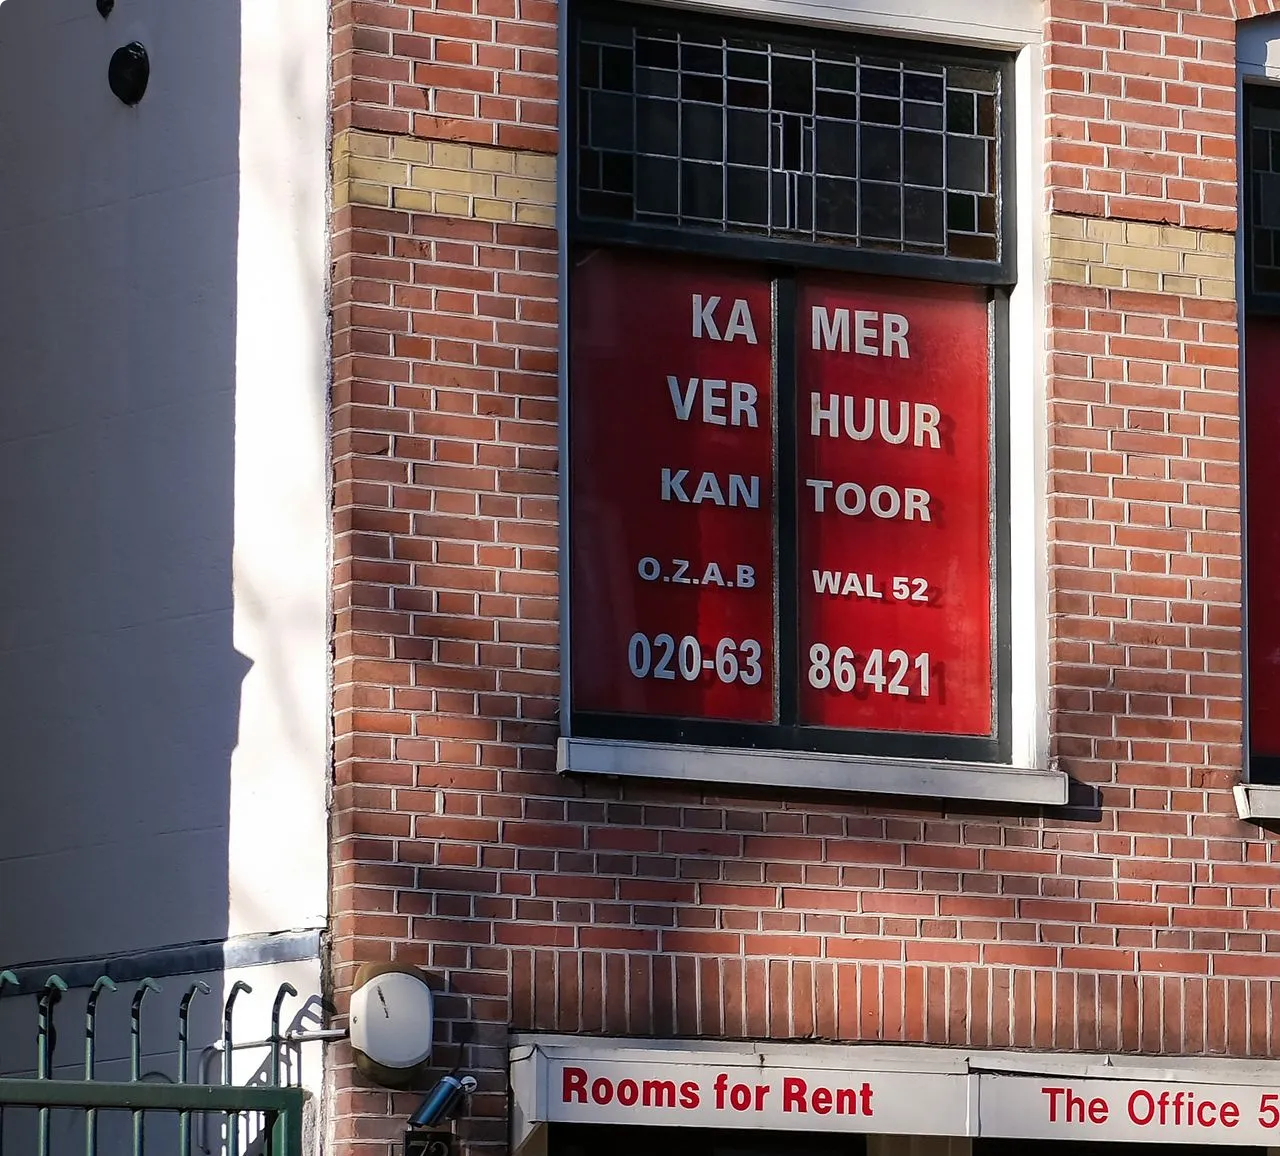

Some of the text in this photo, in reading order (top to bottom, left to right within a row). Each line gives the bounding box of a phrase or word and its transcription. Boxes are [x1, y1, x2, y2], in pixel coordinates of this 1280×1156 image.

[691, 293, 910, 359] KA MER
[666, 375, 941, 449] VER HUUR
[660, 468, 931, 522] KAN TOOR
[637, 556, 929, 602] O.Z.A.B WAL 52
[628, 632, 762, 686] 020-63
[562, 1067, 874, 1117] Rooms for Rent
[1042, 1087, 1109, 1126] The
[1128, 1089, 1240, 1129] Office
